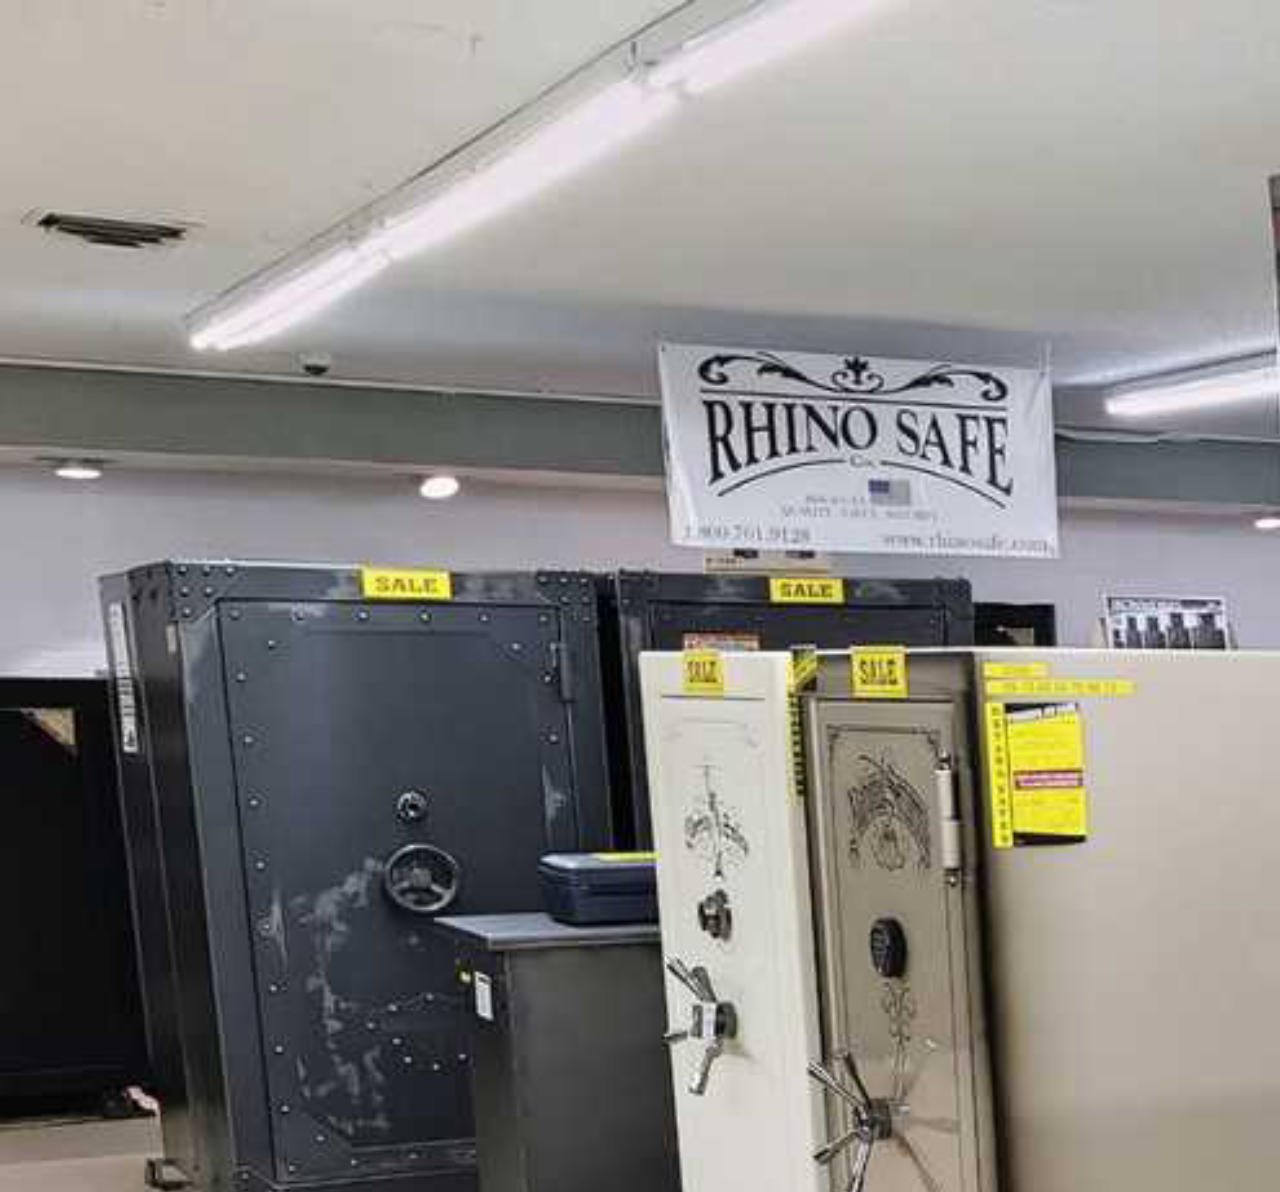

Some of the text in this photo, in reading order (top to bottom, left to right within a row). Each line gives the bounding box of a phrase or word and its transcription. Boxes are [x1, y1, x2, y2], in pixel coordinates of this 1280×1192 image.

[702, 399, 1014, 496] RHINO SAFE
[374, 575, 439, 594] SALE
[779, 581, 833, 599] SALE
[859, 658, 899, 686] SALE
